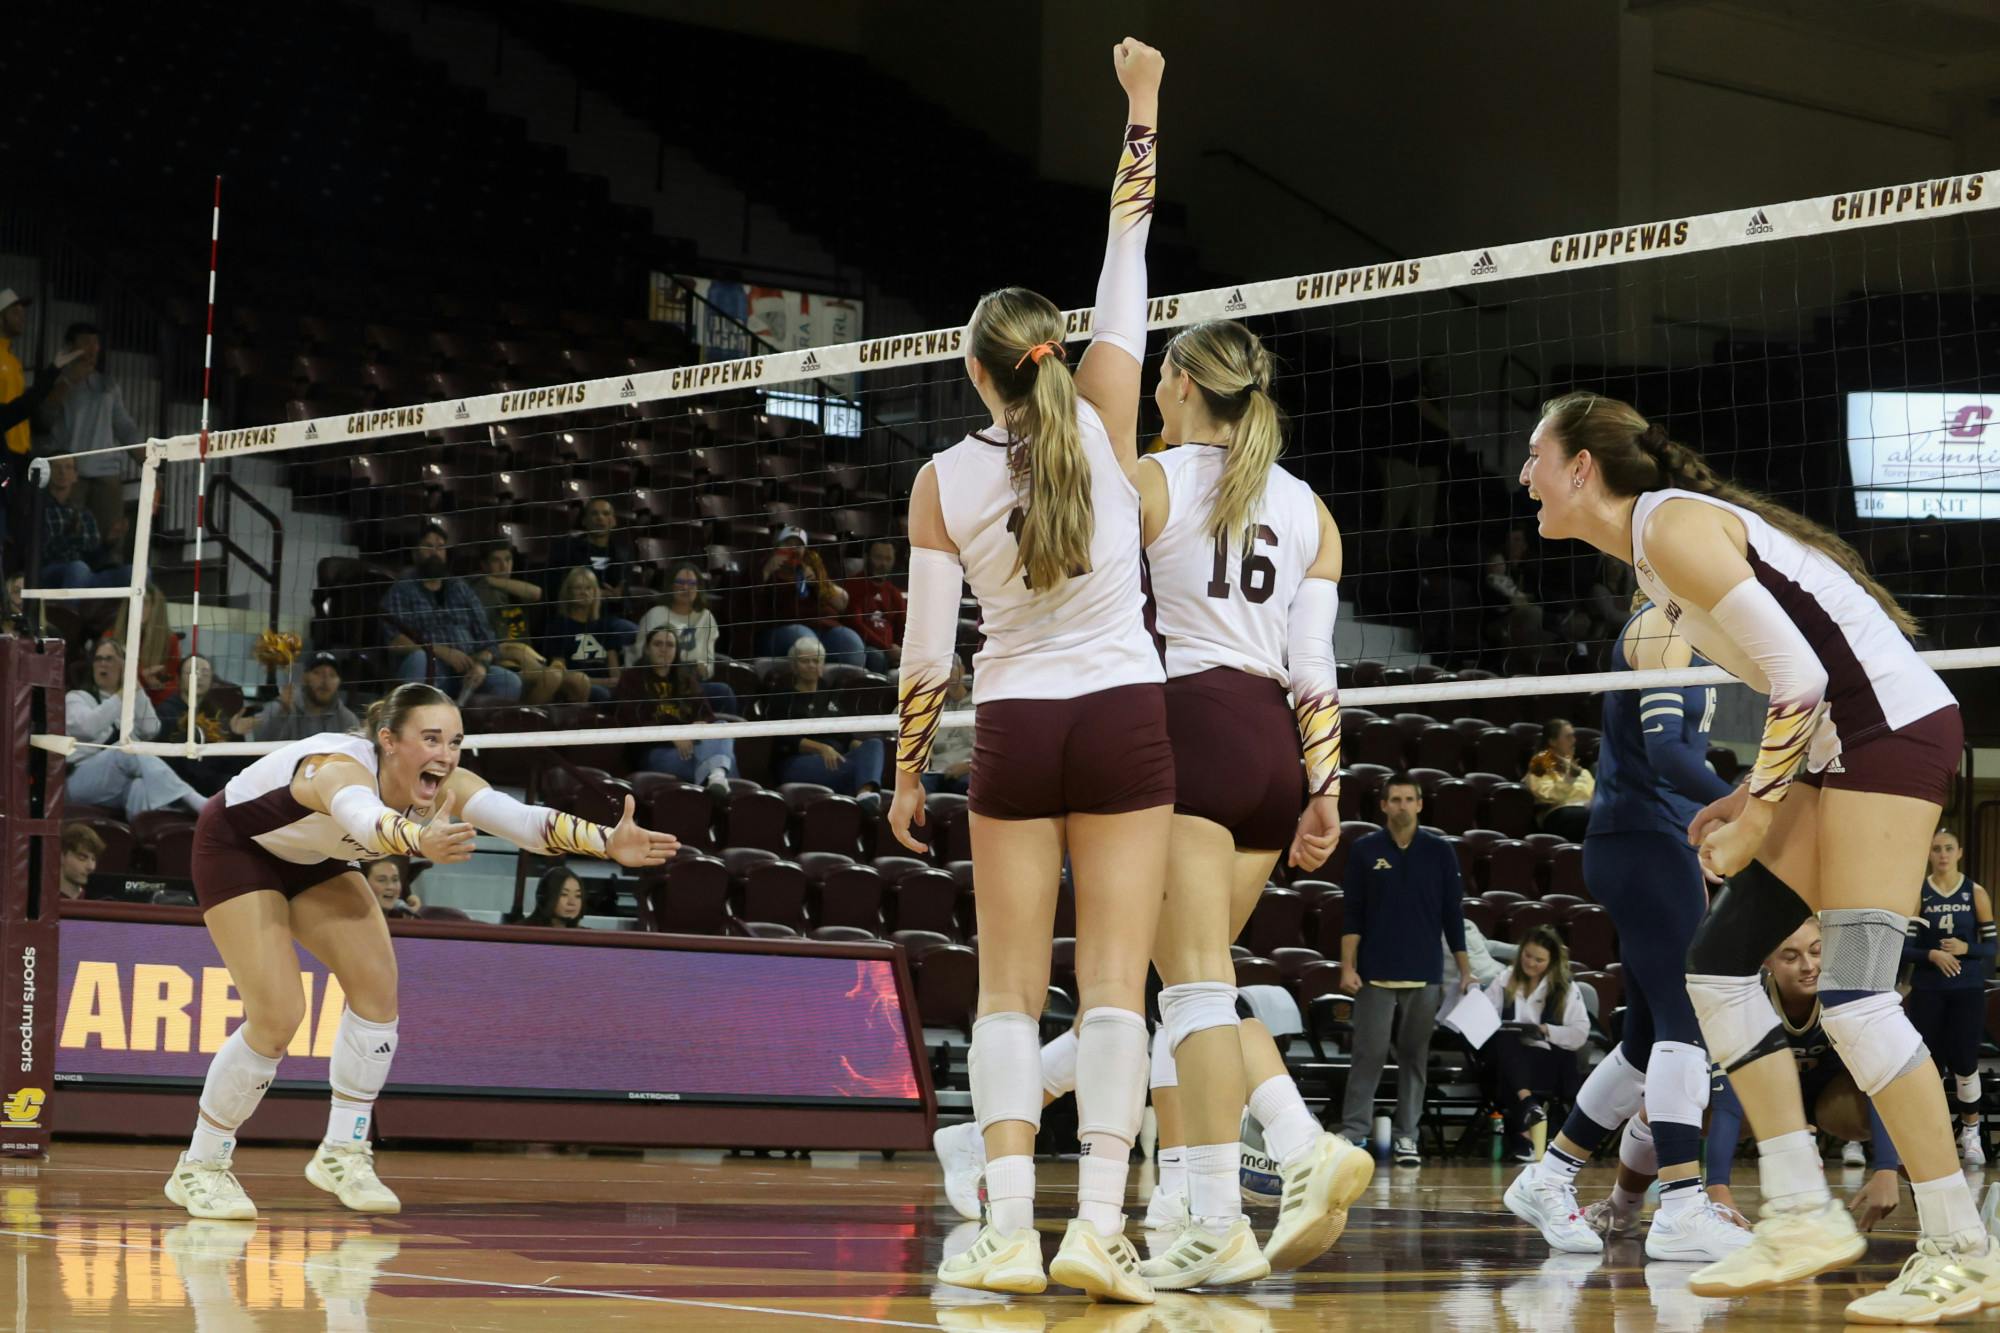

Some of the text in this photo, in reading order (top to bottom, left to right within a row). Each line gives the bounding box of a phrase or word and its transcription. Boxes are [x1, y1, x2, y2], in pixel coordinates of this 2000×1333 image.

[1830, 174, 1985, 222] CHIPPEWAS
[1550, 220, 1690, 265] CHIPPEWAS
[1745, 221, 1774, 236] adidas
[1296, 261, 1421, 301] CHIPPEWAS
[1470, 264, 1498, 276] adidas
[1224, 301, 1247, 312] adidas
[859, 329, 962, 364] CHIPPEWAS
[671, 358, 765, 391] CHIPPEWAS
[500, 383, 587, 414] CHIPPEWAS
[346, 406, 425, 434] CHIPPEWAS
[1887, 432, 2000, 464] alumni
[1921, 497, 1968, 512] EXIT
[1207, 522, 1279, 605] 16
[571, 633, 608, 660] A
[1373, 857, 1393, 870] A
[1924, 903, 1972, 914] AKRON
[1938, 913, 1955, 935] 4
[20, 946, 37, 1073] sports imports
